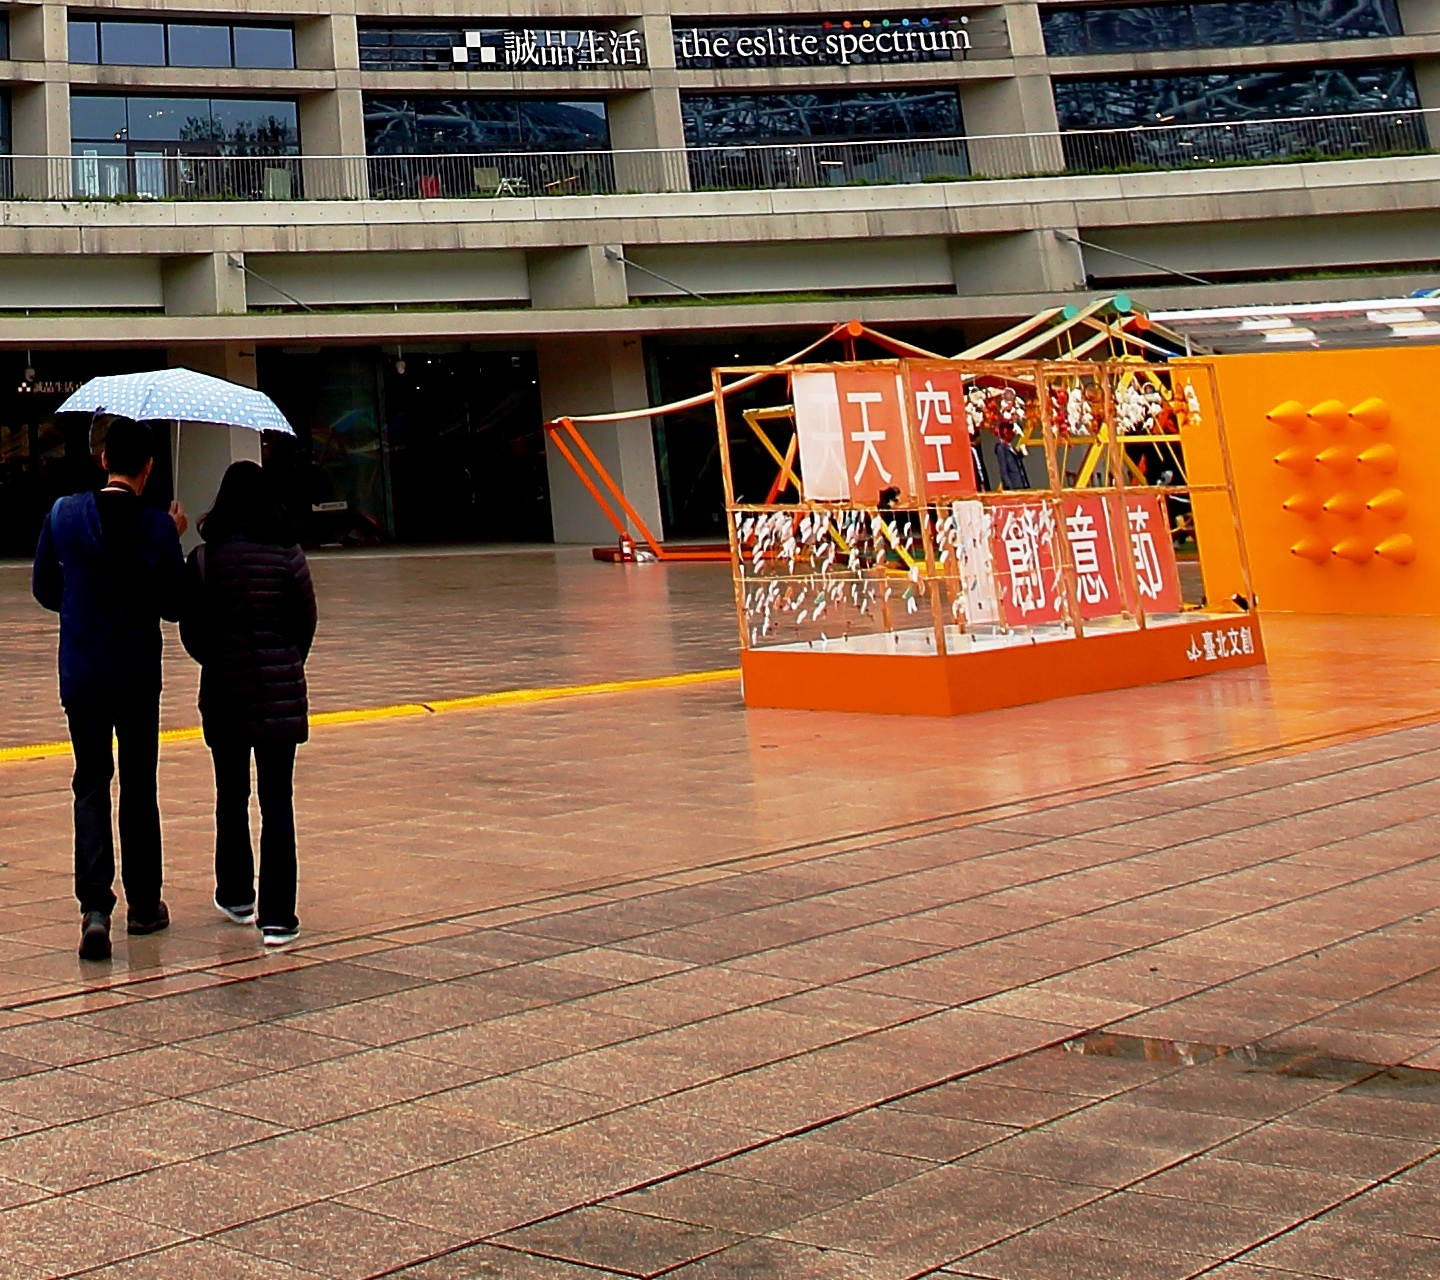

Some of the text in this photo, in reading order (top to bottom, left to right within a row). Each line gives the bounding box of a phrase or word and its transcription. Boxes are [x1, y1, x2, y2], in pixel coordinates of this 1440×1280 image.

[504, 27, 972, 66] 誠品生活 the eslite spectrum
